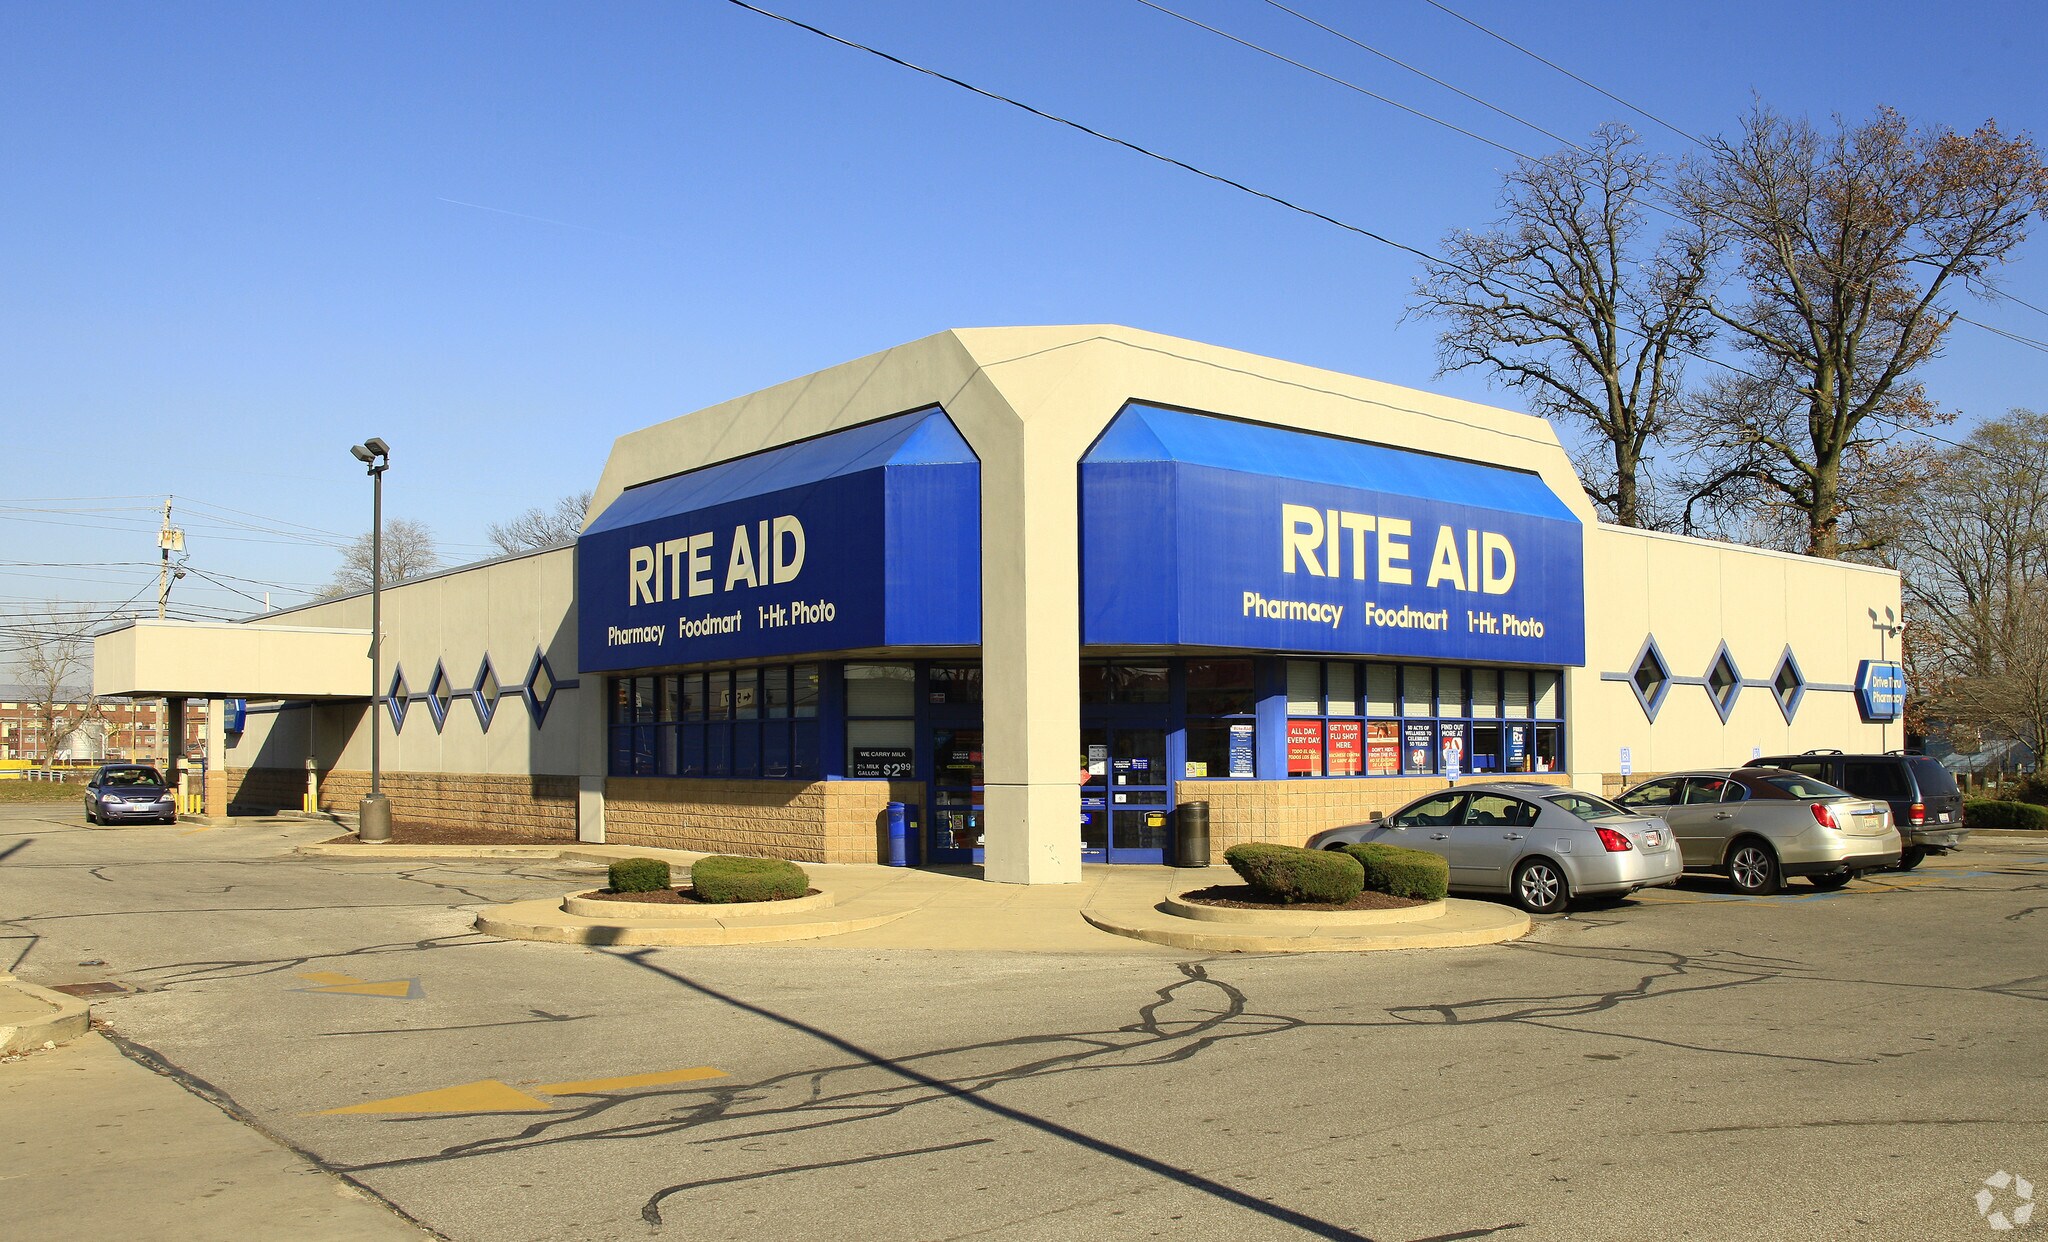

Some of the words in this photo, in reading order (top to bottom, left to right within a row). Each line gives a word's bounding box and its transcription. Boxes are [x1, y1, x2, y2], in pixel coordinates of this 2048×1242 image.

[629, 531, 714, 607] RITE
[724, 514, 806, 592] AID
[1282, 503, 1412, 585] RITE
[1426, 525, 1516, 595] AID
[608, 625, 666, 647] Pharmacy
[679, 610, 742, 639] Foodmart
[758, 603, 788, 629] 1-Hr.
[791, 599, 836, 625] Photo
[1243, 591, 1344, 629] Pharmacy
[1365, 602, 1448, 631] Foodmart
[1467, 610, 1500, 635] 1-Hr.
[1502, 613, 1545, 639] Photo
[1872, 676, 1888, 688] Drive
[1872, 691, 1903, 706] Pharmacy
